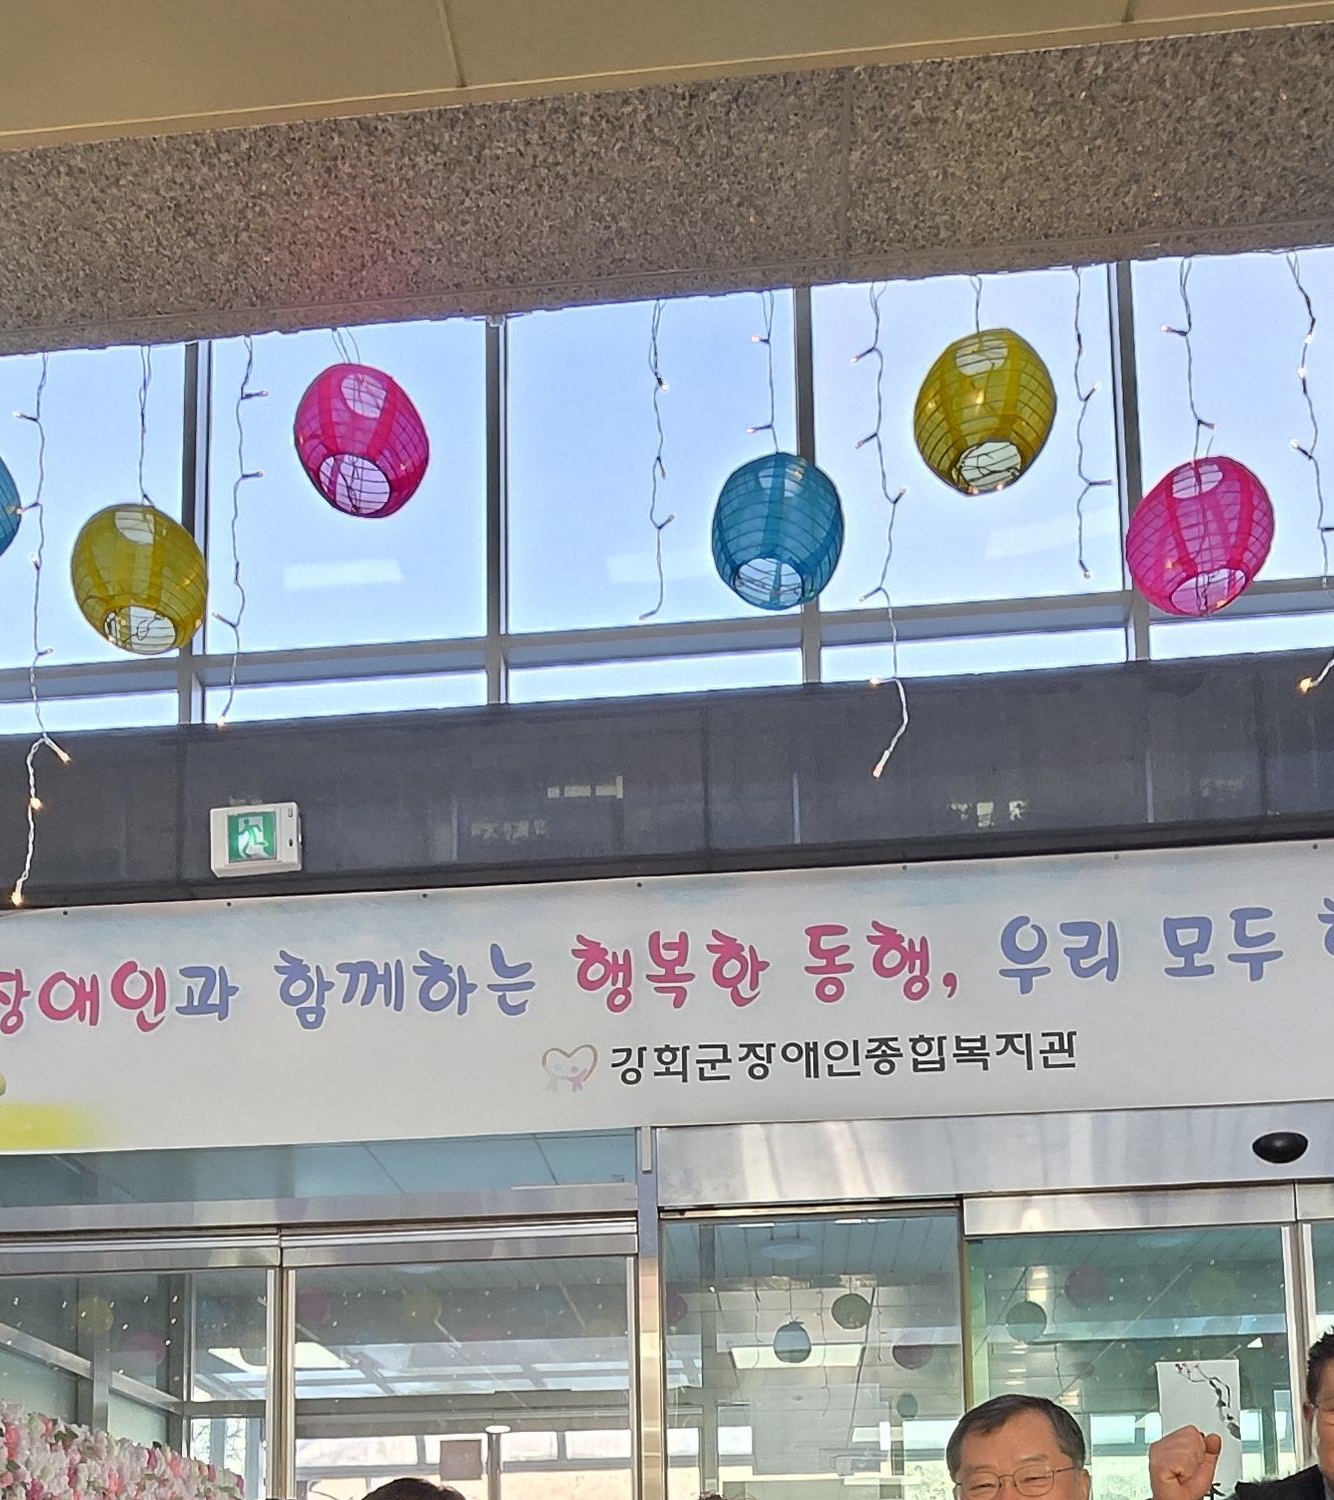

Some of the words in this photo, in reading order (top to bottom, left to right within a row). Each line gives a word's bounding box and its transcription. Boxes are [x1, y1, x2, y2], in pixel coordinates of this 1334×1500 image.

[274, 942, 533, 1030] 함께하는
[571, 928, 769, 1014] 행복한
[803, 919, 959, 1004] 동행,
[998, 914, 1121, 994] 우리
[1161, 907, 1283, 981] 모두
[609, 1029, 1079, 1087] 강화군장애인종합복지관
